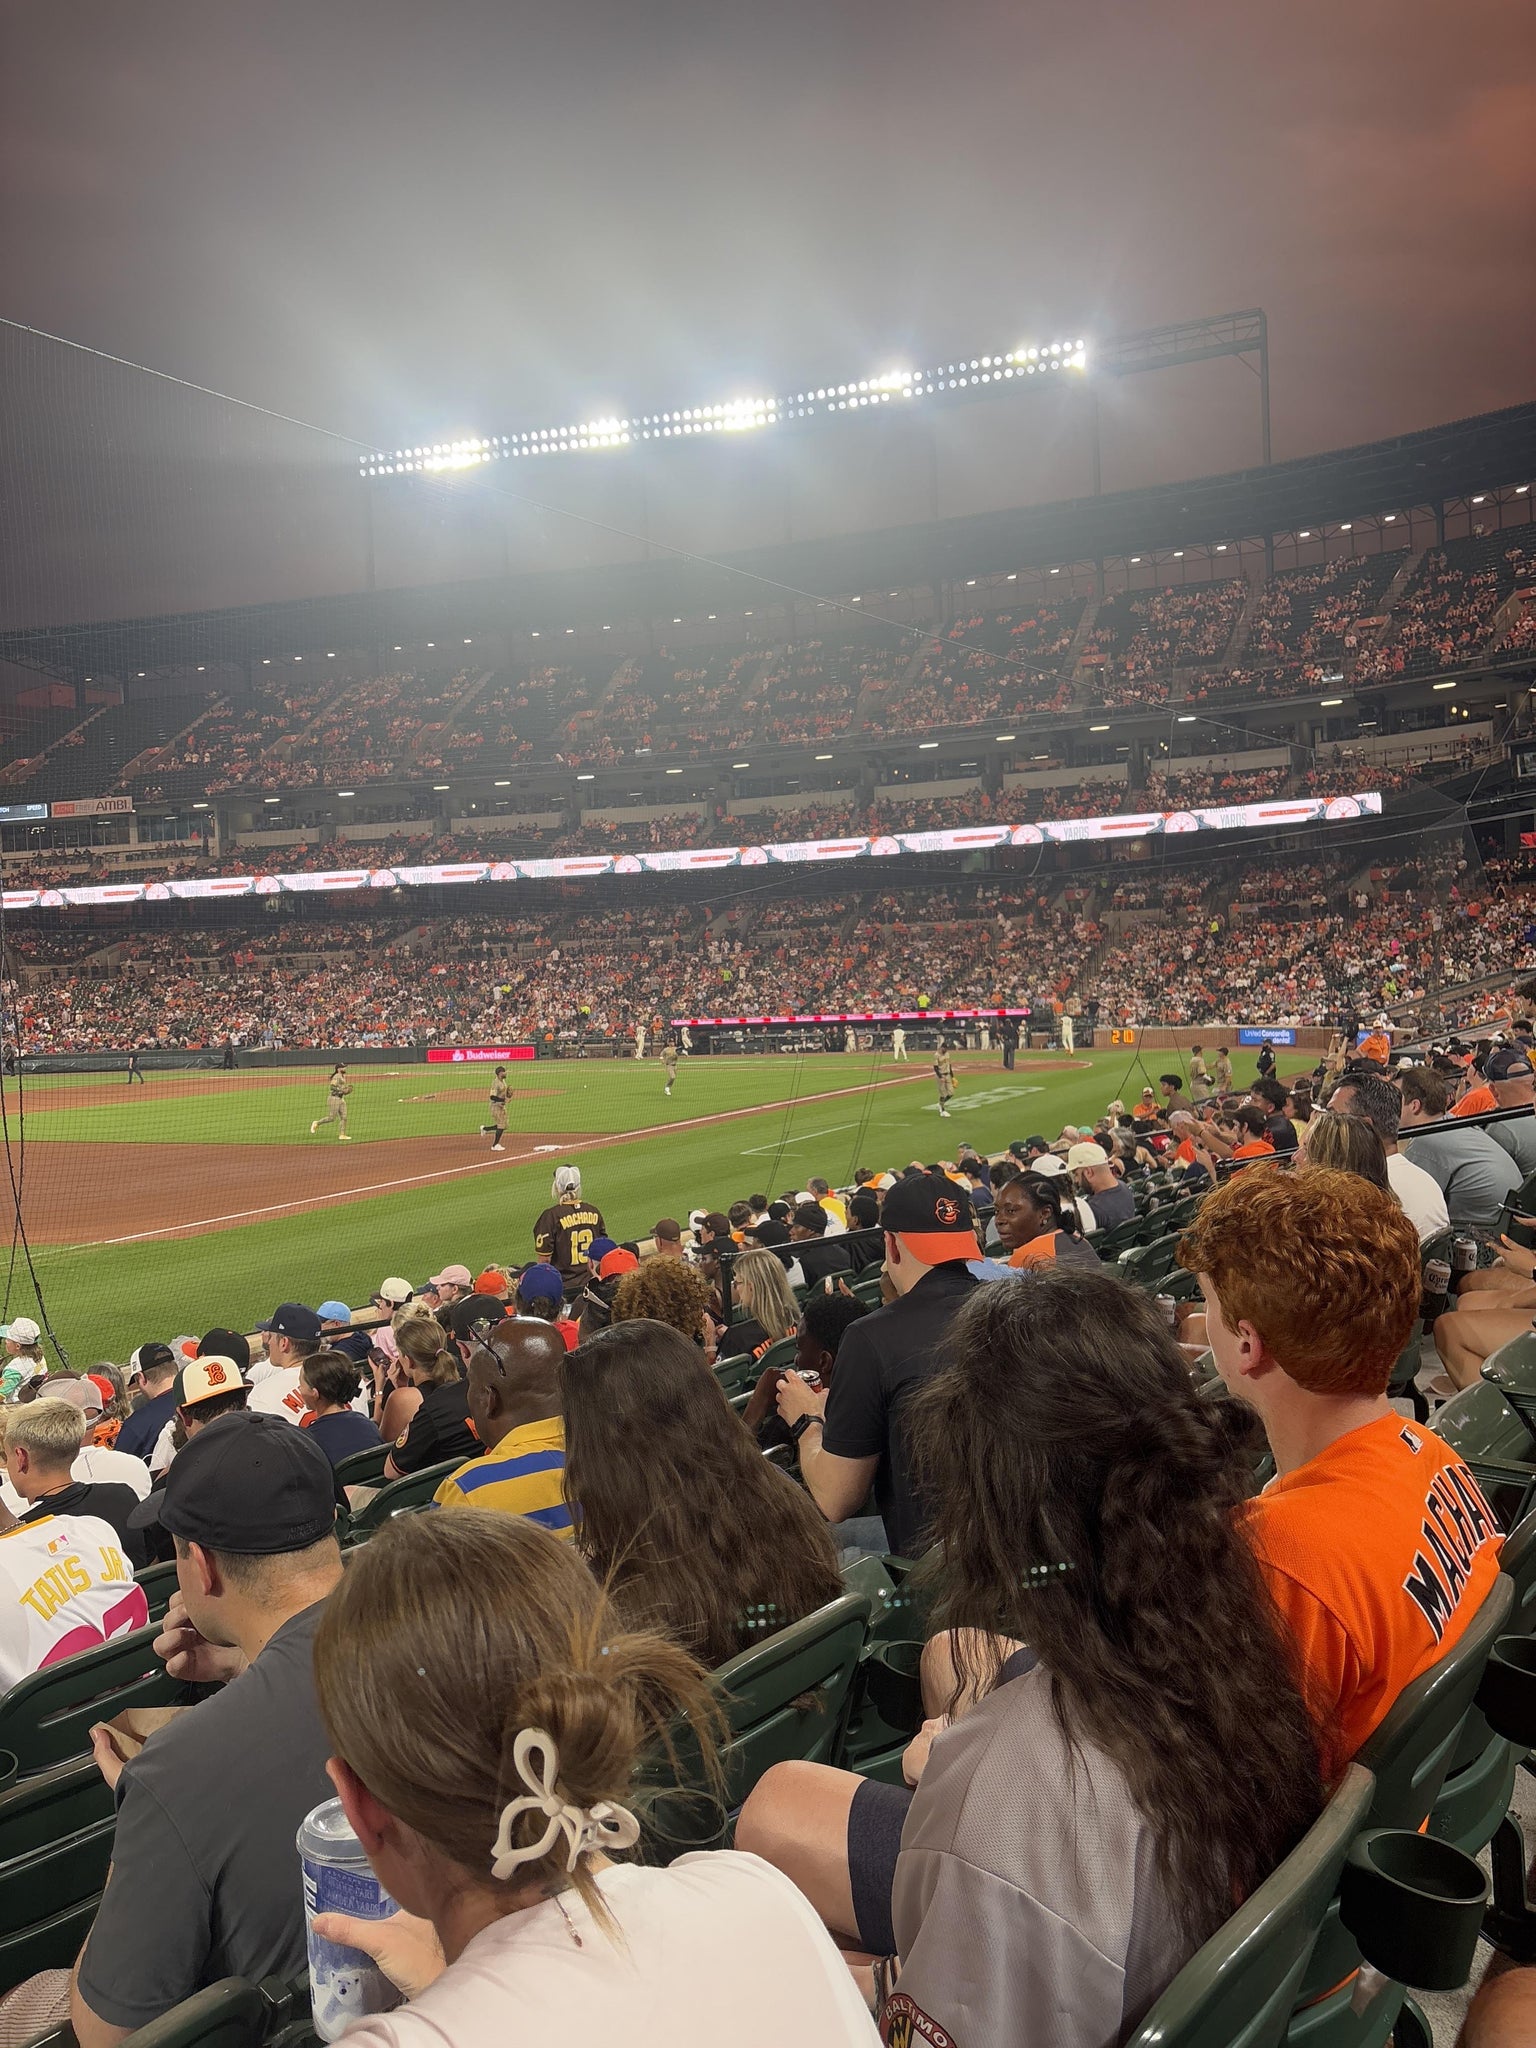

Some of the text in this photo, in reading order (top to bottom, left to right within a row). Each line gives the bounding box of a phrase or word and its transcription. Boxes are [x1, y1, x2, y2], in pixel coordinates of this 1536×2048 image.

[95, 799, 128, 812] AMBI
[1244, 1029, 1290, 1038] United Concordia
[1272, 1036, 1291, 1044] dental
[466, 1049, 511, 1060] Budweiser
[559, 1211, 599, 1230] MACHADO
[203, 1361, 227, 1387] B
[18, 1555, 93, 1621] TATIS
